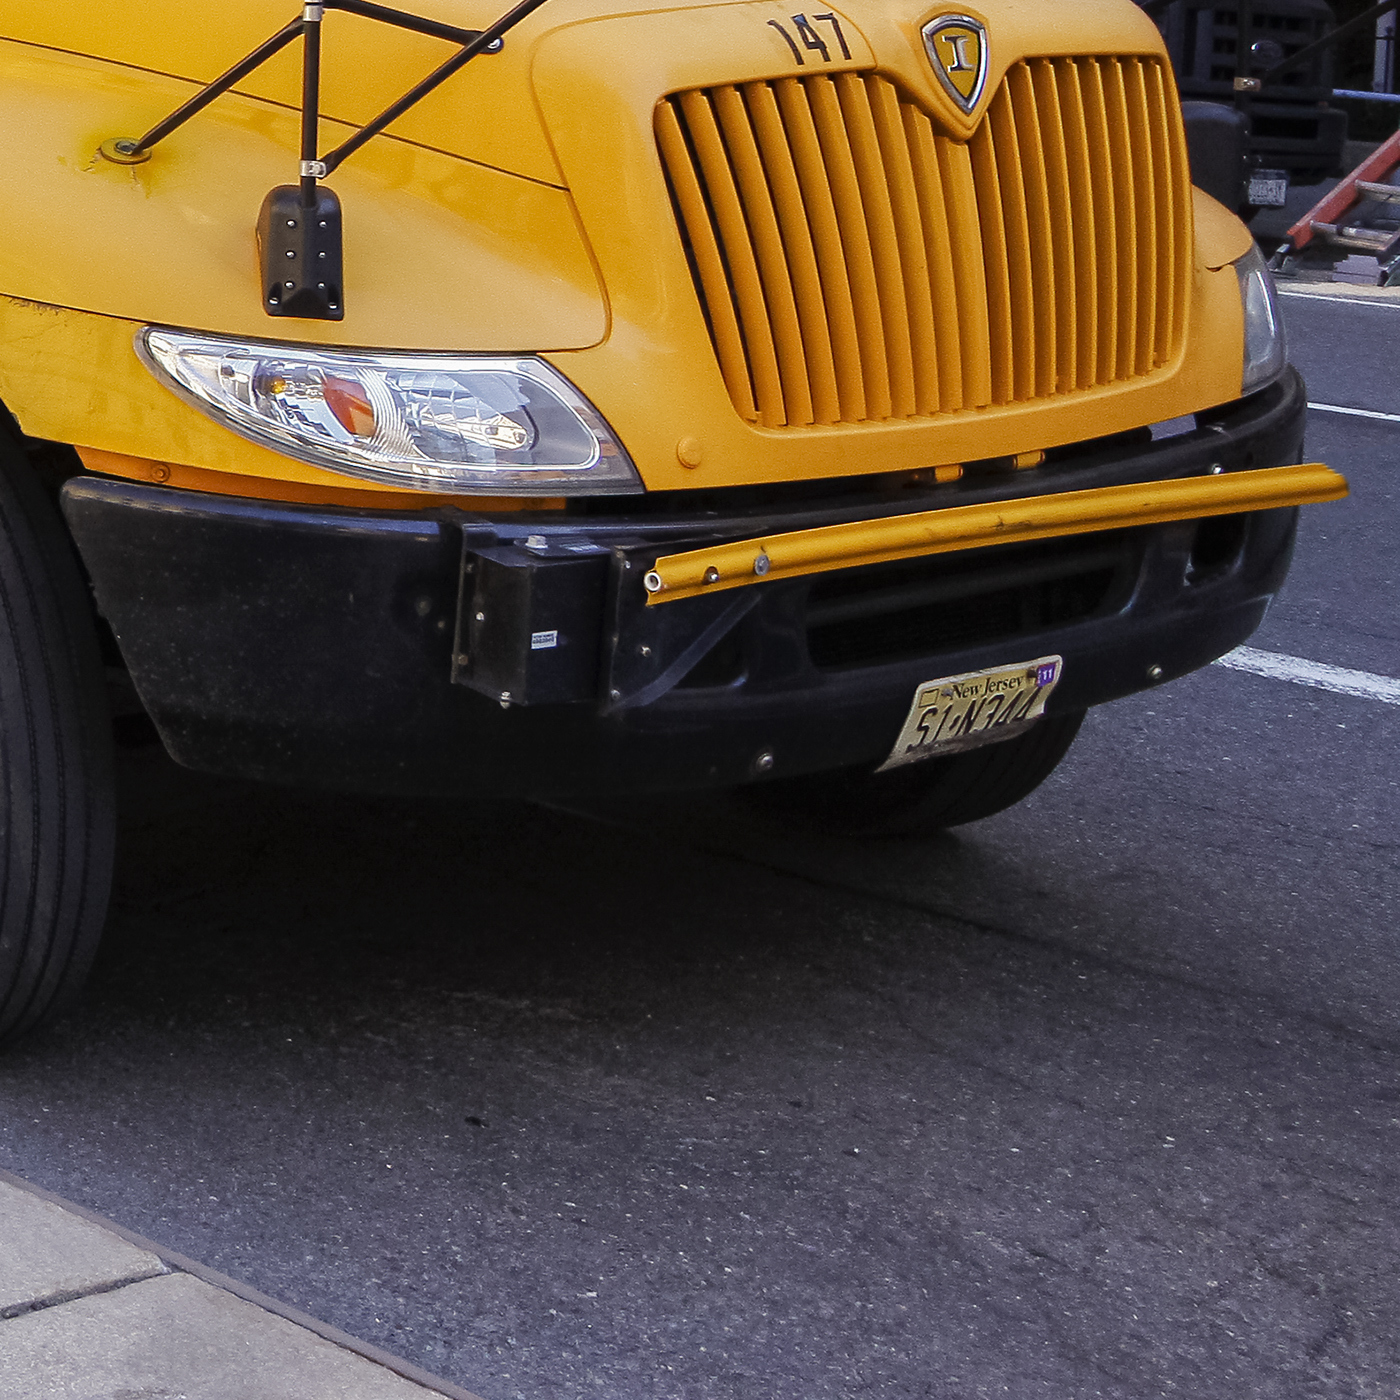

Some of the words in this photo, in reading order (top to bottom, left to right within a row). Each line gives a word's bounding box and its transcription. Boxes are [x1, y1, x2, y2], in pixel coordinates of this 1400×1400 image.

[767, 12, 852, 66] 147
[952, 683, 983, 699] New
[983, 677, 1025, 698] Jersey
